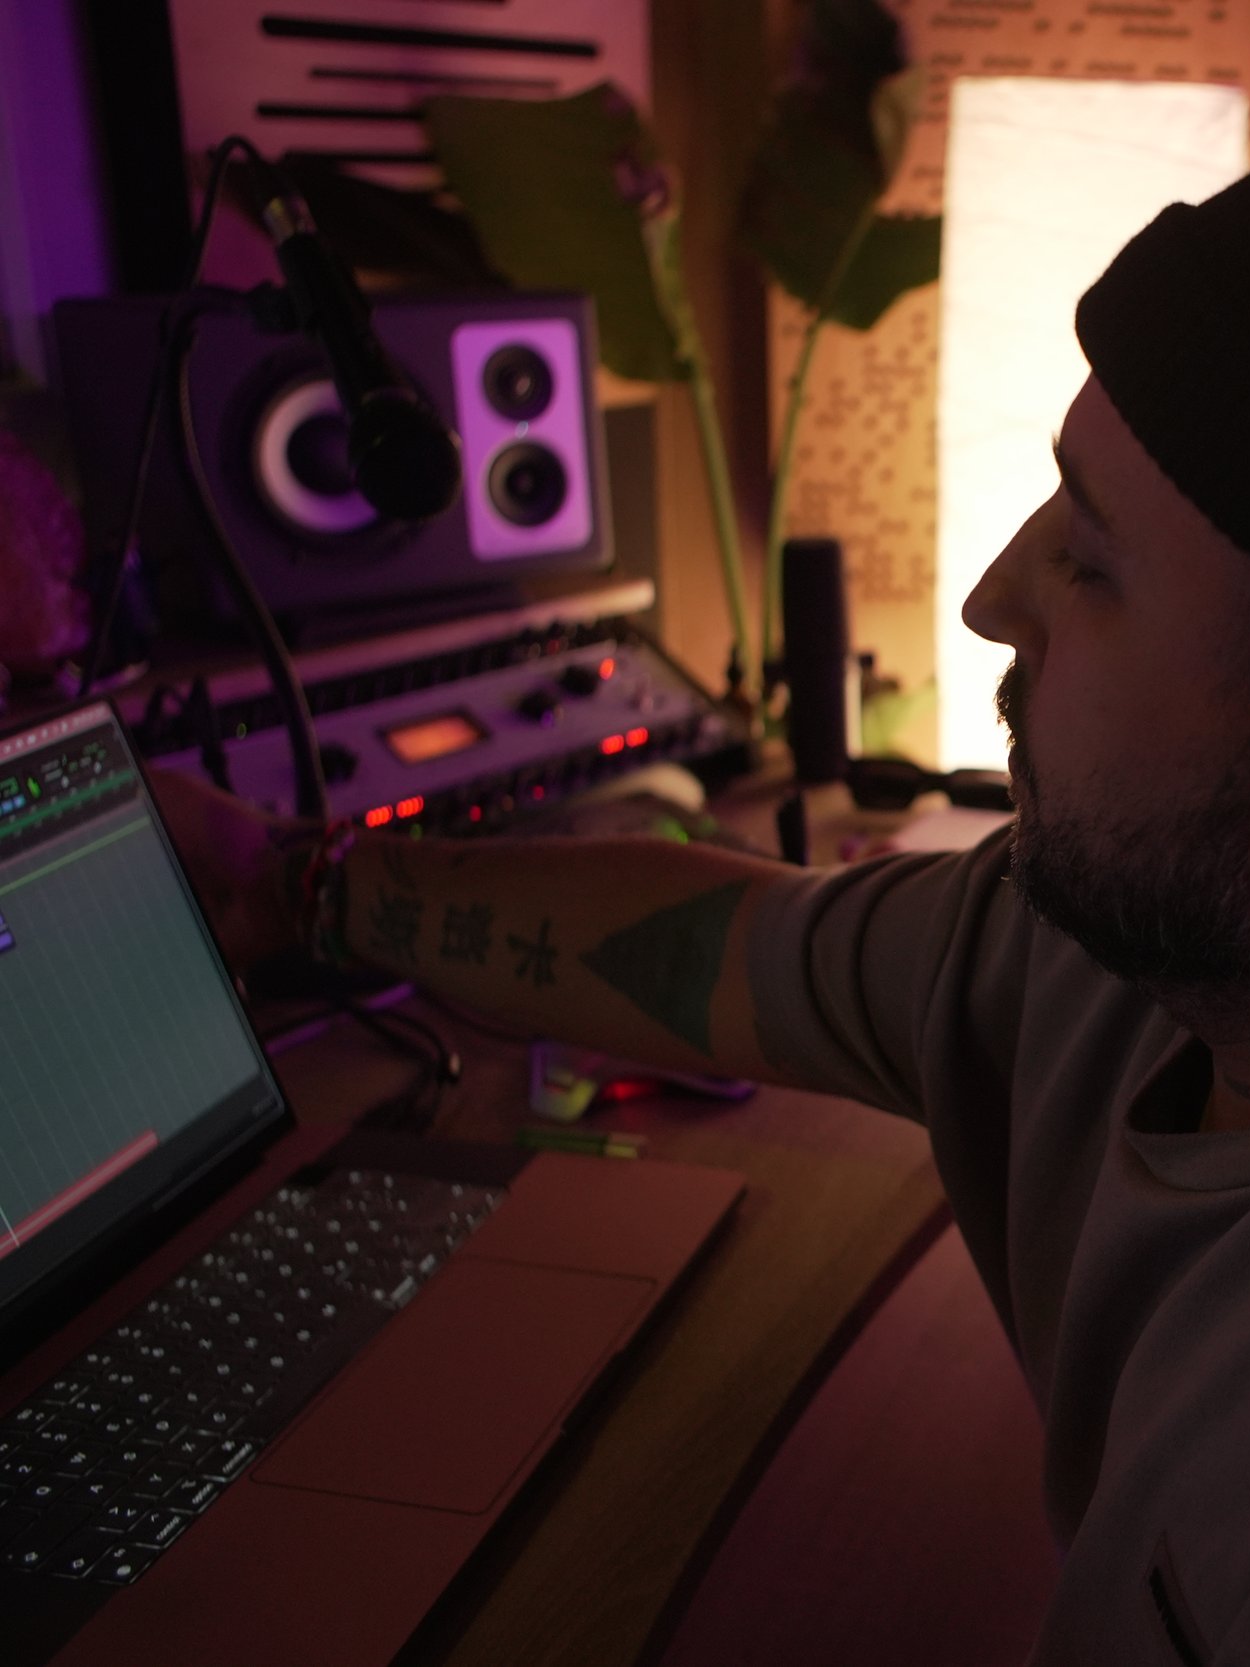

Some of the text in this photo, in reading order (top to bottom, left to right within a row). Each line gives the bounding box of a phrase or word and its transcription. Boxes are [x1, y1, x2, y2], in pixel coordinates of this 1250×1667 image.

[181, 1441, 197, 1453] X
[69, 1451, 87, 1464] W
[17, 1464, 33, 1474] 2
[148, 1472, 163, 1483] Y
[89, 1483, 104, 1495] A
